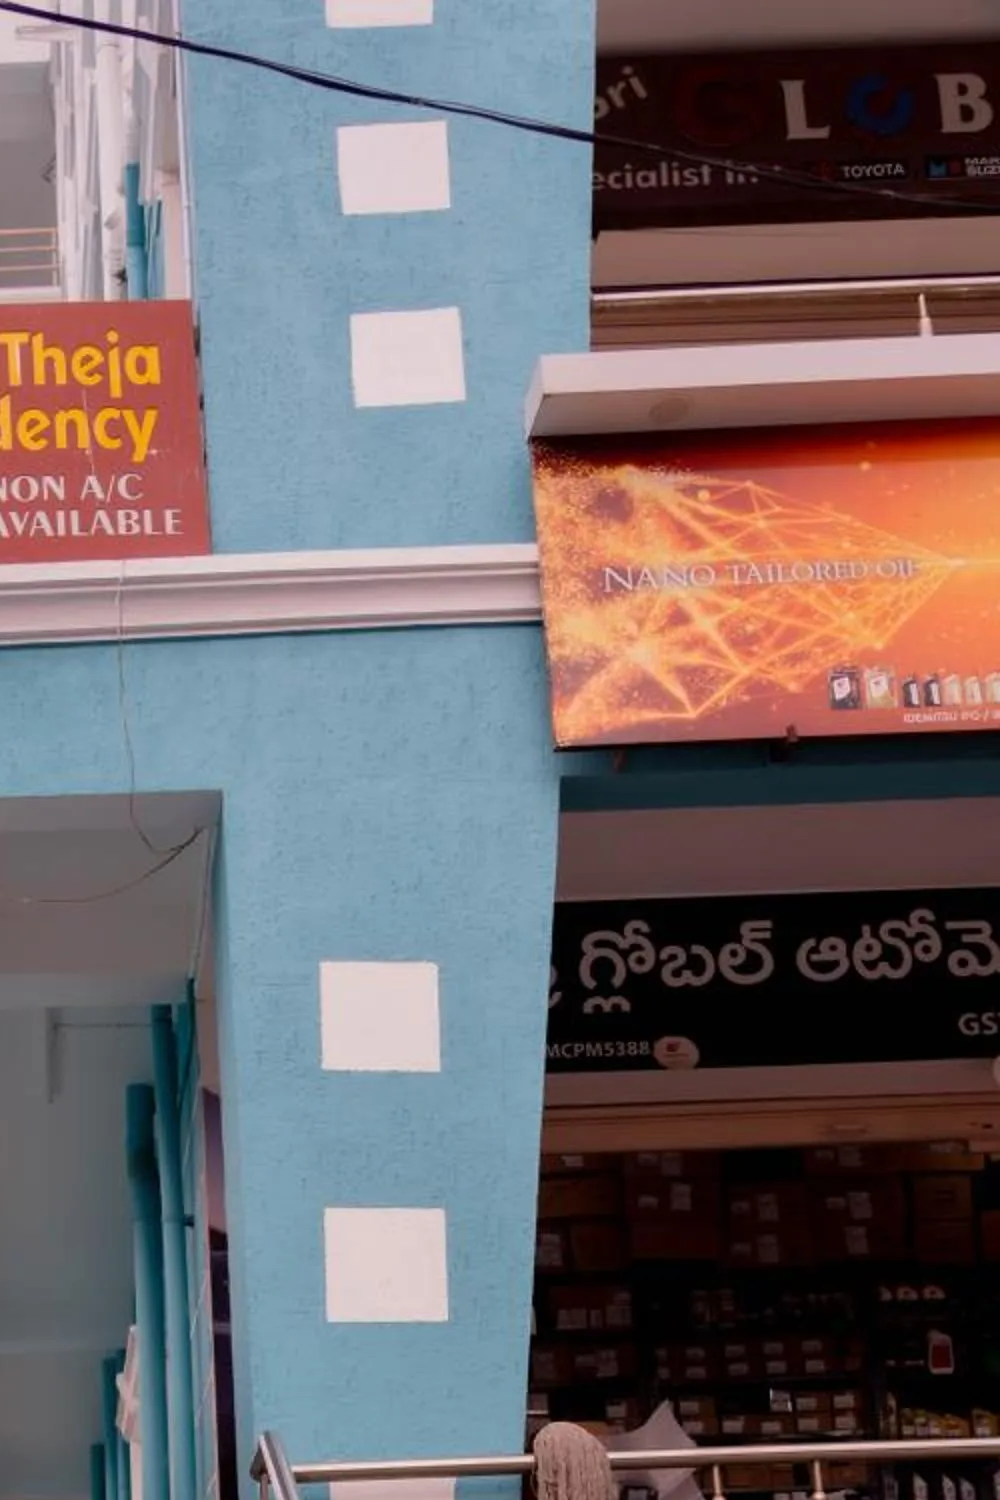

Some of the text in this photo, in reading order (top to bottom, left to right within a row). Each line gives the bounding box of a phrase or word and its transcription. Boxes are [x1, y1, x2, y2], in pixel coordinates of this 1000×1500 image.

[841, 163, 905, 179] TOYOTA
[80, 472, 144, 503] A/C
[603, 565, 715, 593] NANO
[725, 560, 870, 586] TAILORED
[579, 919, 775, 1013] గ్లోబల్
[957, 1011, 1000, 1036] GS
